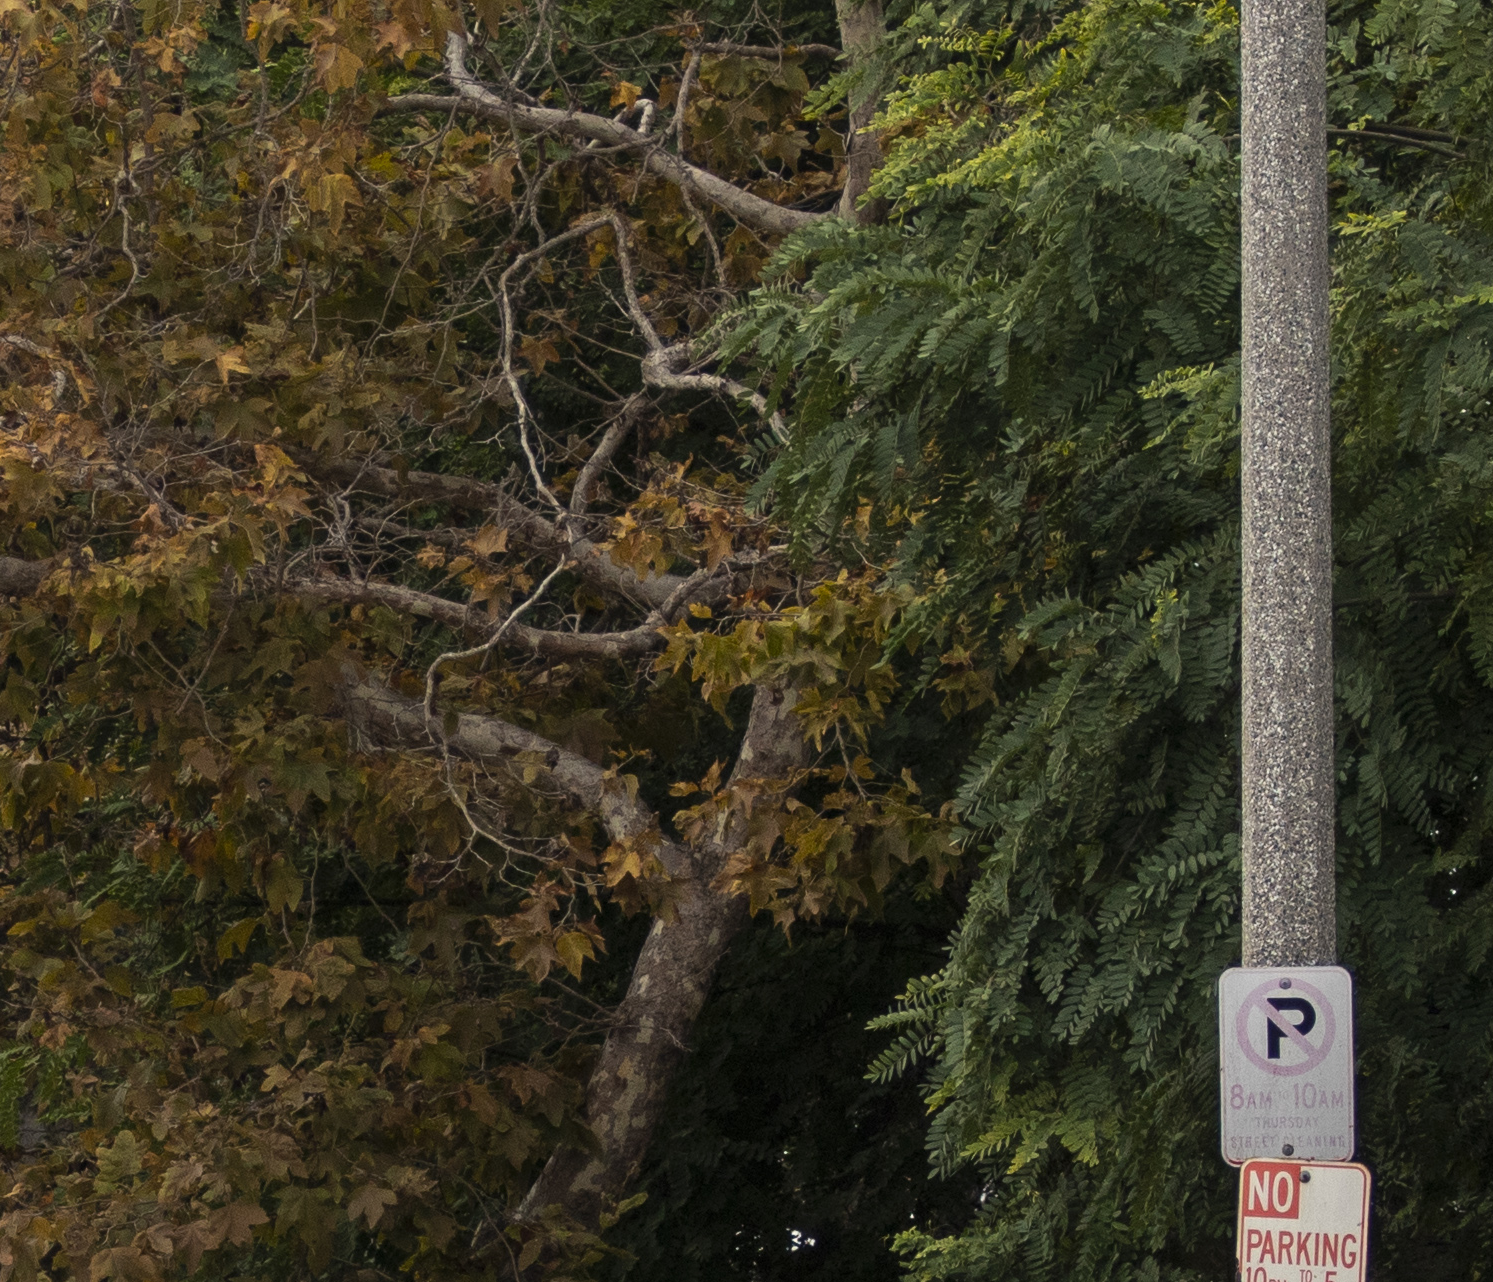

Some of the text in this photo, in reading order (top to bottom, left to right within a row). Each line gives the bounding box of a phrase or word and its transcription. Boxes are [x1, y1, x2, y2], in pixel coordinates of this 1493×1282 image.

[1230, 1084, 1272, 1110] 8AM
[1294, 1083, 1344, 1109] 10AM
[1248, 1170, 1294, 1213] NO
[1246, 1229, 1357, 1269] PARKING
